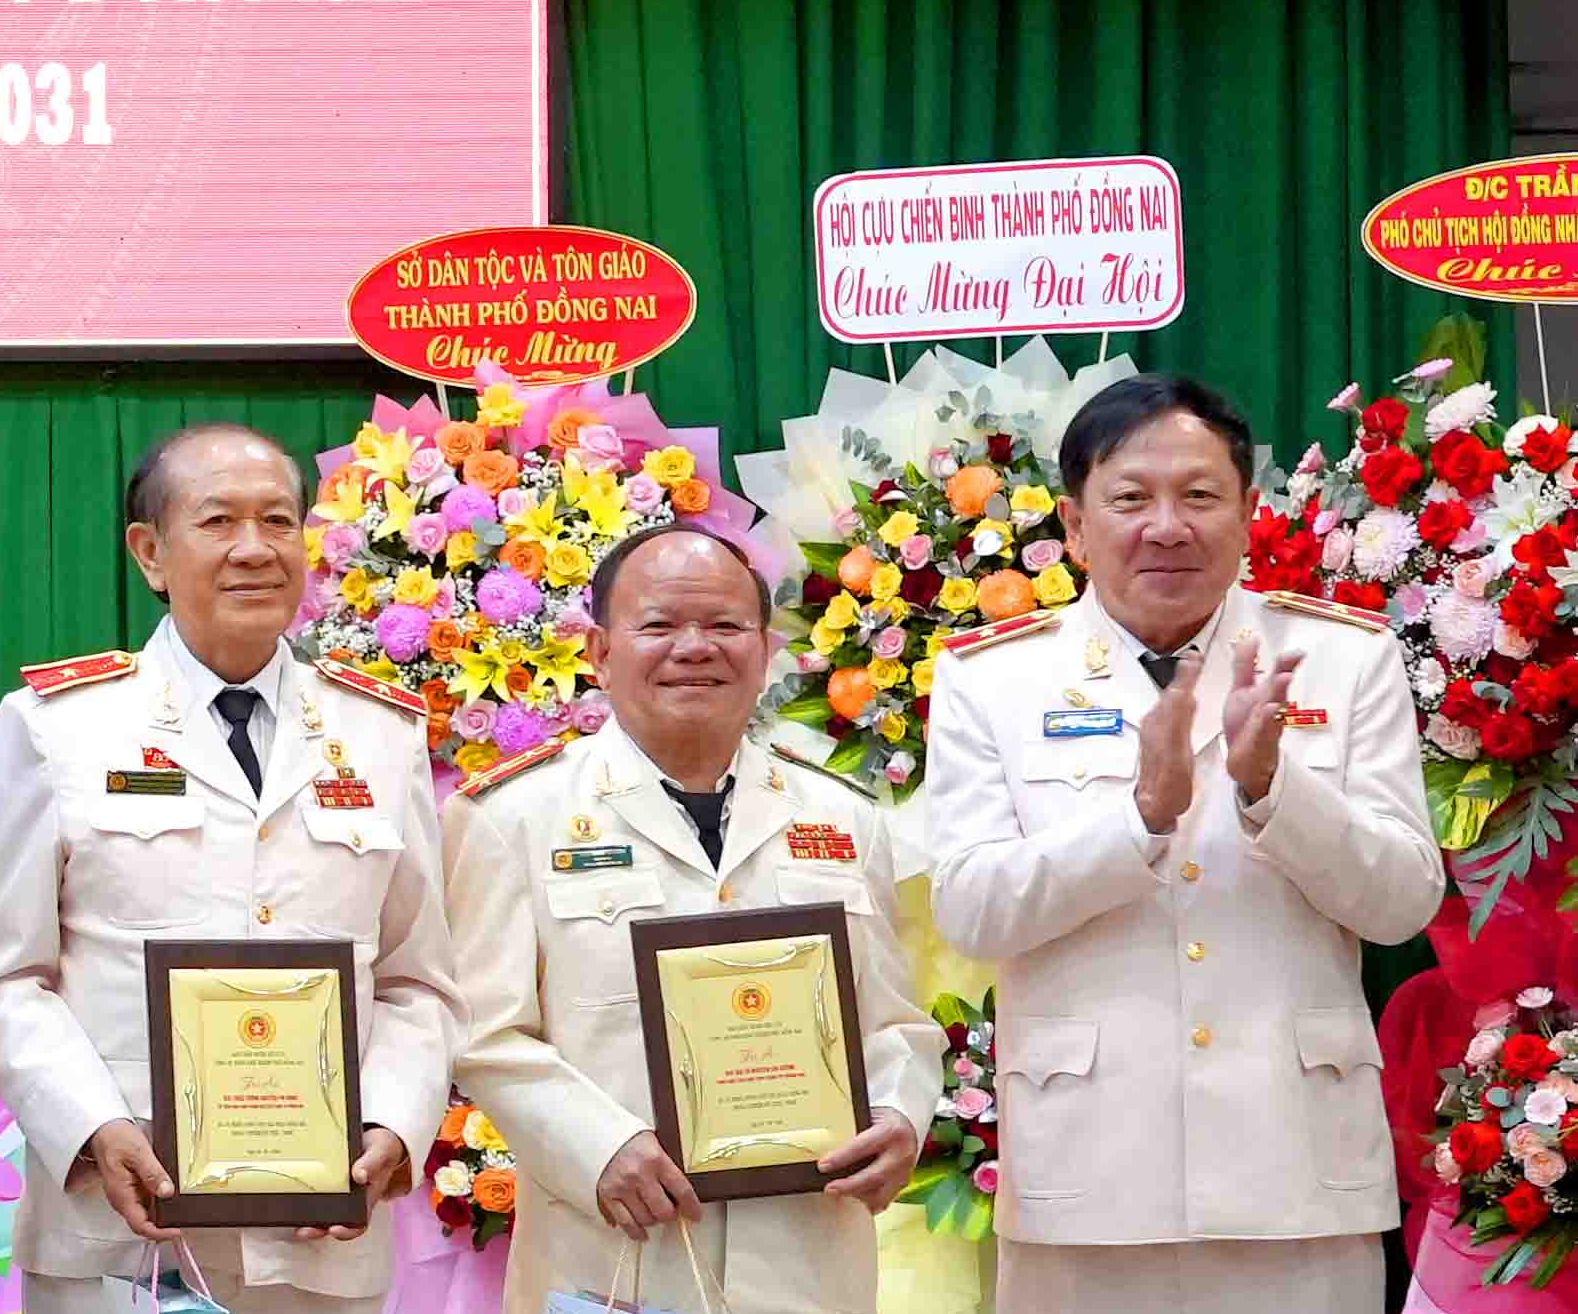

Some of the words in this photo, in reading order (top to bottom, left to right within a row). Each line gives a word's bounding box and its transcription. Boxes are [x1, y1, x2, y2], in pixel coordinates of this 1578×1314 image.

[1465, 175, 1509, 202] Đ/C
[830, 192, 856, 258] HỘI
[862, 199, 894, 257] CỰU
[900, 181, 943, 244] CHIẾN
[949, 194, 985, 241] BINH
[991, 180, 1045, 238] THÀNH
[1051, 173, 1082, 235] PHỐ
[1090, 171, 1132, 234] ĐỒNG
[1140, 185, 1167, 232] NAI
[1380, 212, 1409, 249] PHÓ
[1412, 207, 1442, 248] CHỦ
[1446, 216, 1479, 254] TỊCH
[1482, 210, 1508, 253] HỘI
[1510, 202, 1551, 245] ĐỒNG
[1555, 211, 1578, 243] NH
[396, 251, 423, 288] SỞ
[427, 251, 469, 288] DÂN
[474, 248, 515, 290] TỘC
[520, 246, 547, 283] VÀ
[552, 245, 593, 282] TÔN
[598, 242, 646, 279] GIÁO
[834, 265, 908, 320] Chúc
[917, 260, 1012, 322] Mừng
[1023, 255, 1085, 317] Đại
[1100, 252, 1164, 315] Hội
[1436, 257, 1563, 282] Chúc
[384, 297, 471, 330] THÀNH
[477, 289, 528, 327] PHỐ
[536, 287, 608, 324] ĐỒNG
[614, 295, 658, 319] NAI
[425, 334, 510, 369] Chúc
[515, 330, 618, 370] Mừng
